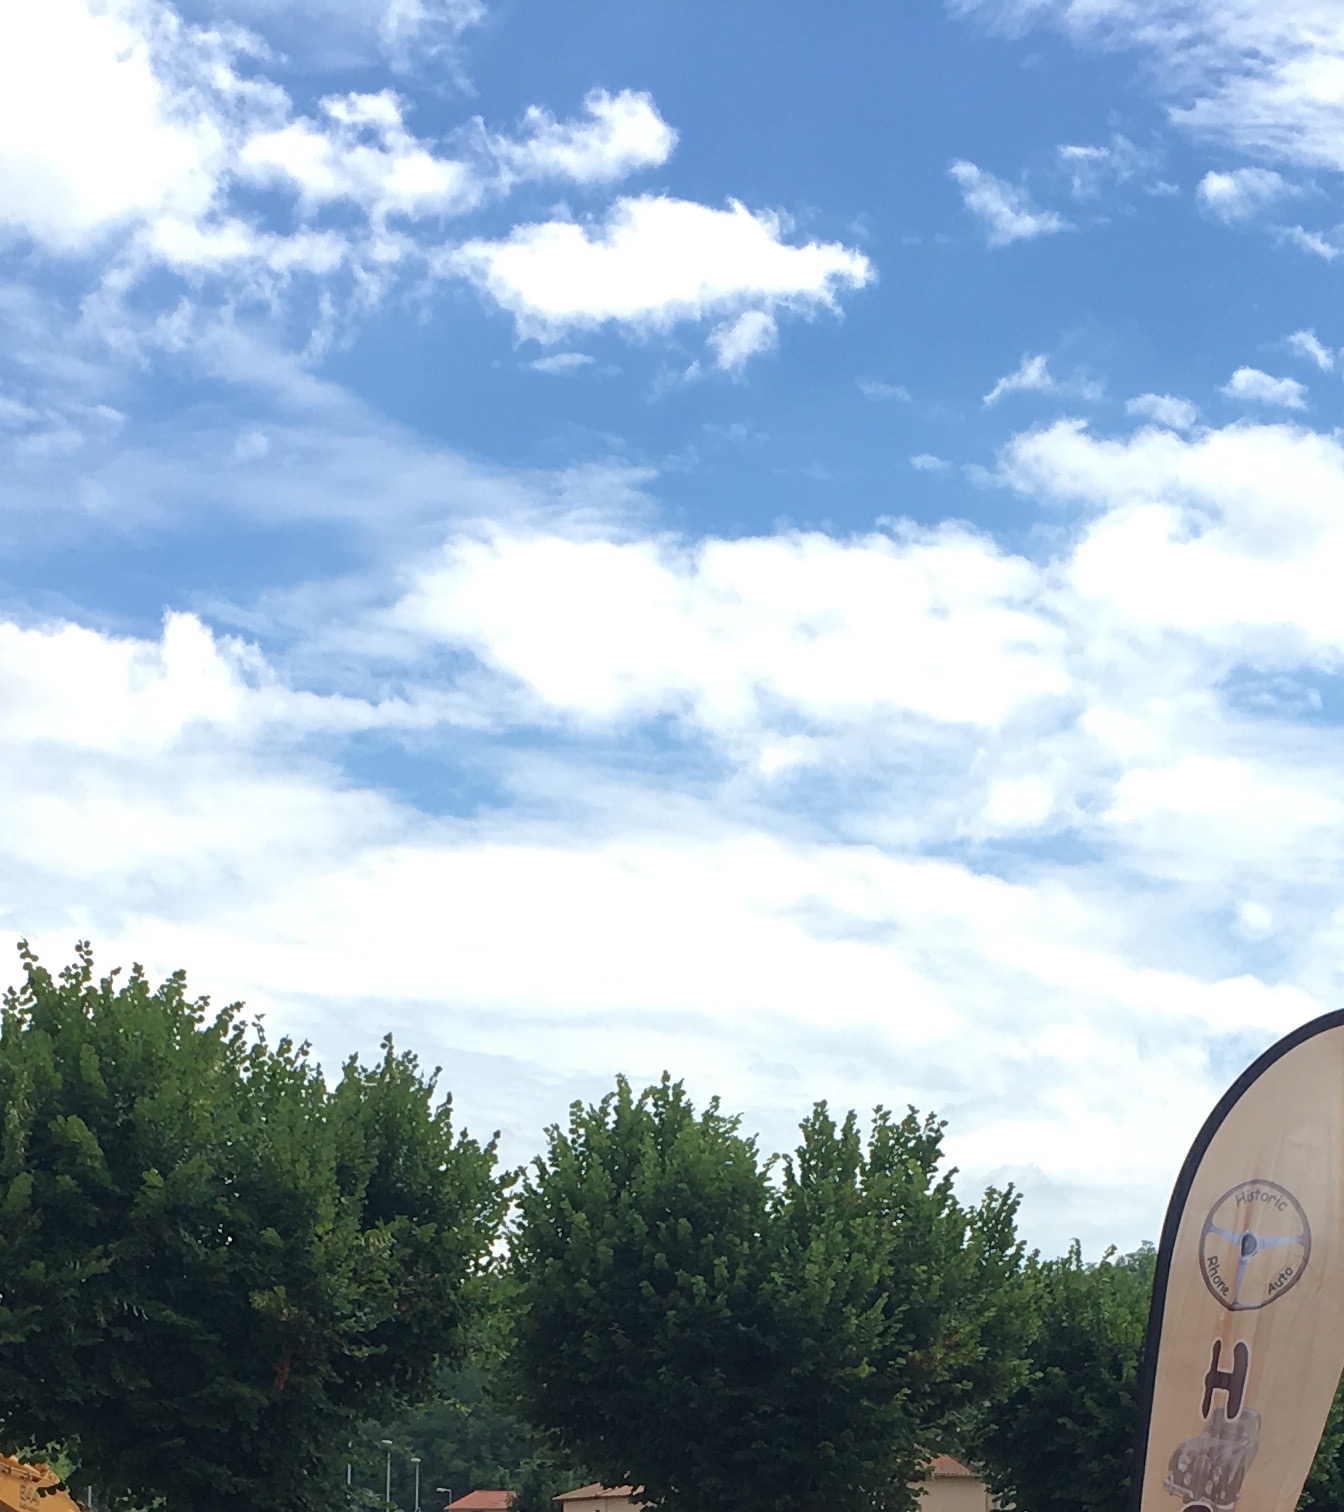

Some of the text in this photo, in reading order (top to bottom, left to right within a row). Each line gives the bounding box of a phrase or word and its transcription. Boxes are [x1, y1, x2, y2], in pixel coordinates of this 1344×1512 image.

[1235, 1189, 1288, 1212] Historic
[1207, 1255, 1230, 1297] Rhone
[1268, 1267, 1294, 1295] Auto
